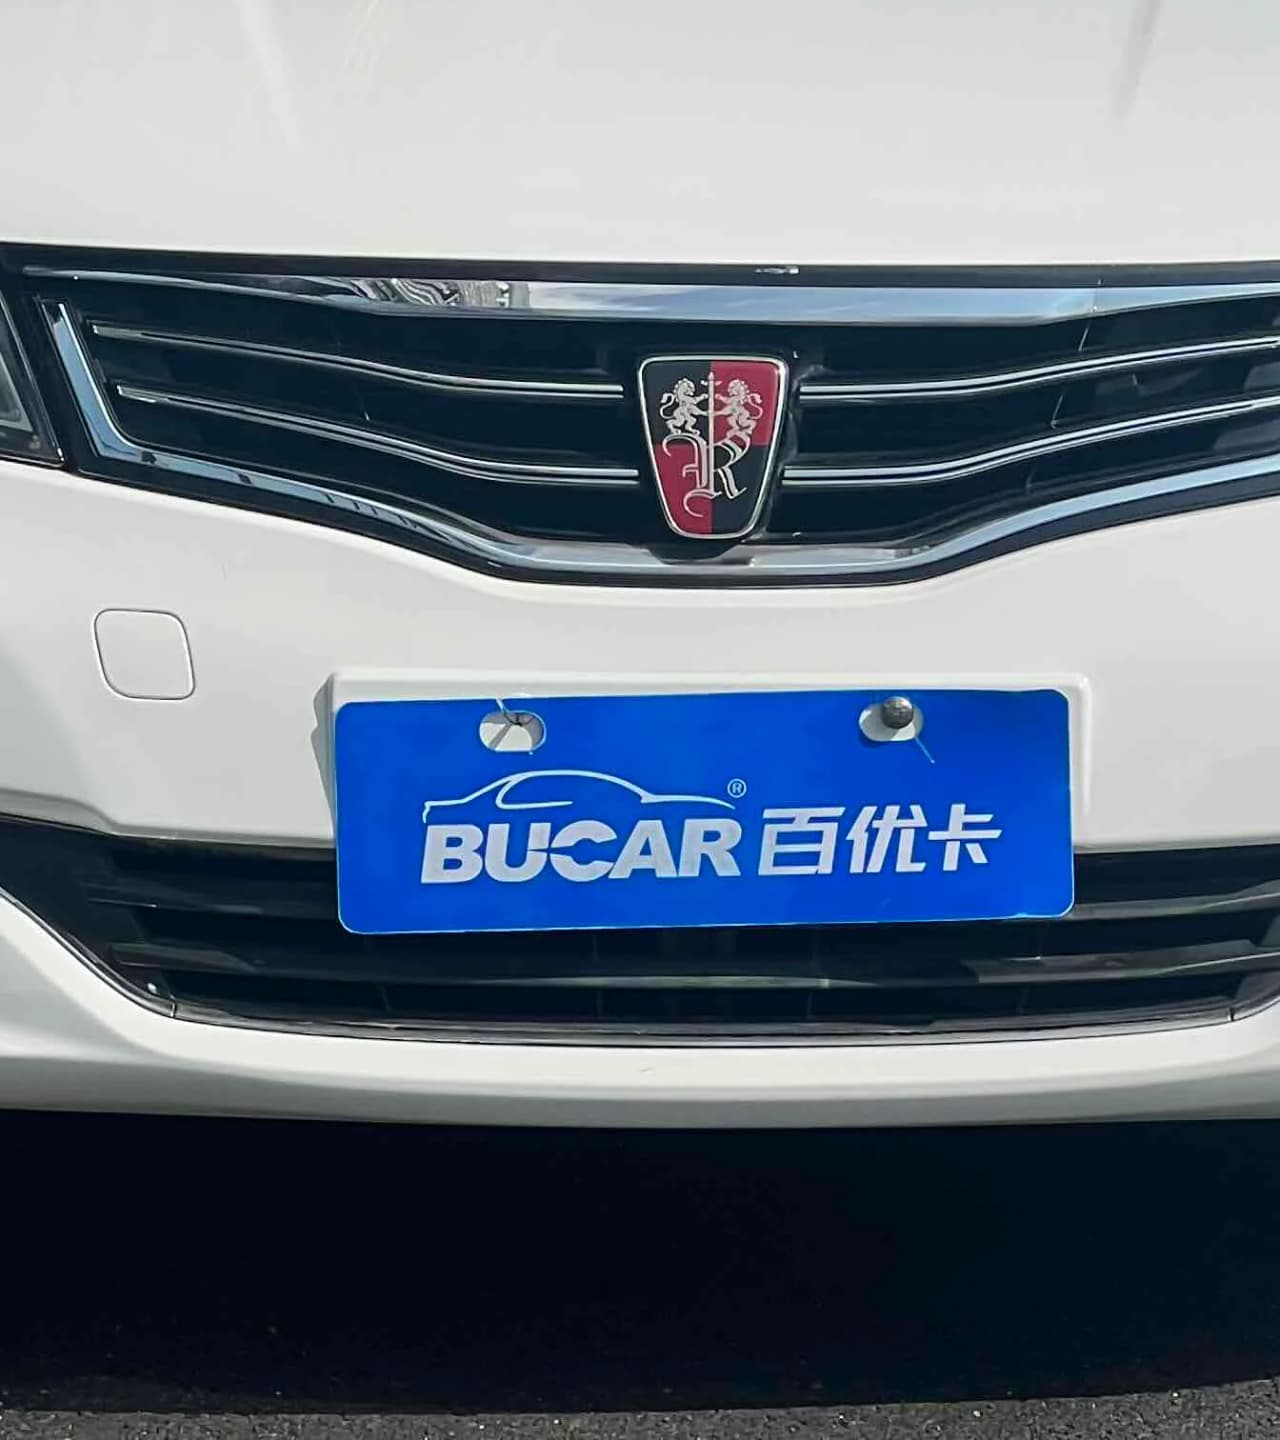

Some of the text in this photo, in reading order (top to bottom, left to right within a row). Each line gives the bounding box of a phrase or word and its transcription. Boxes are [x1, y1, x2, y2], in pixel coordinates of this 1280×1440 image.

[421, 803, 1004, 885] BUCAR 百优卡
